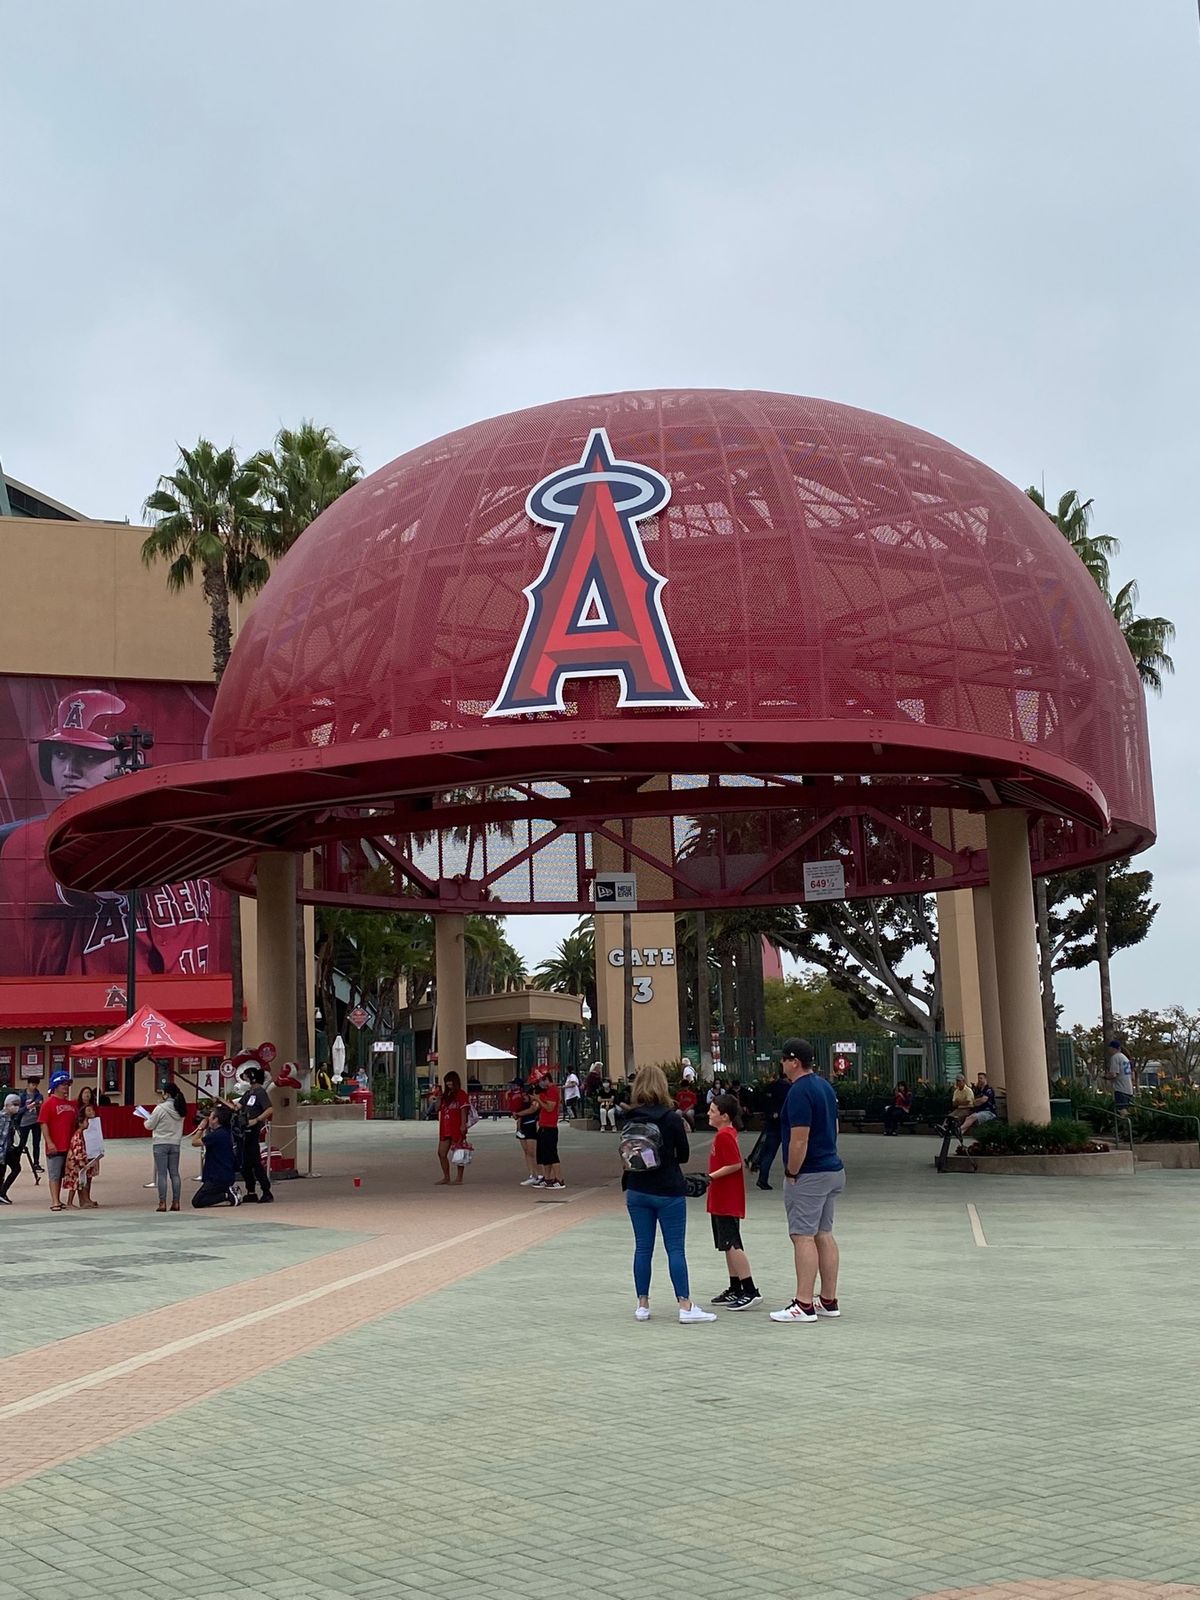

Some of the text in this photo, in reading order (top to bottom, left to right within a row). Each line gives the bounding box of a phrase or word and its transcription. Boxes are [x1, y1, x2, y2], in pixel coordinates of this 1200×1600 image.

[482, 427, 704, 719] A
[63, 699, 84, 729] A
[810, 879, 827, 889] 649
[608, 948, 675, 967] GATE
[104, 985, 127, 1008] A
[632, 976, 654, 1004] 3
[141, 1013, 179, 1046] A
[838, 1058, 845, 1069] 3
